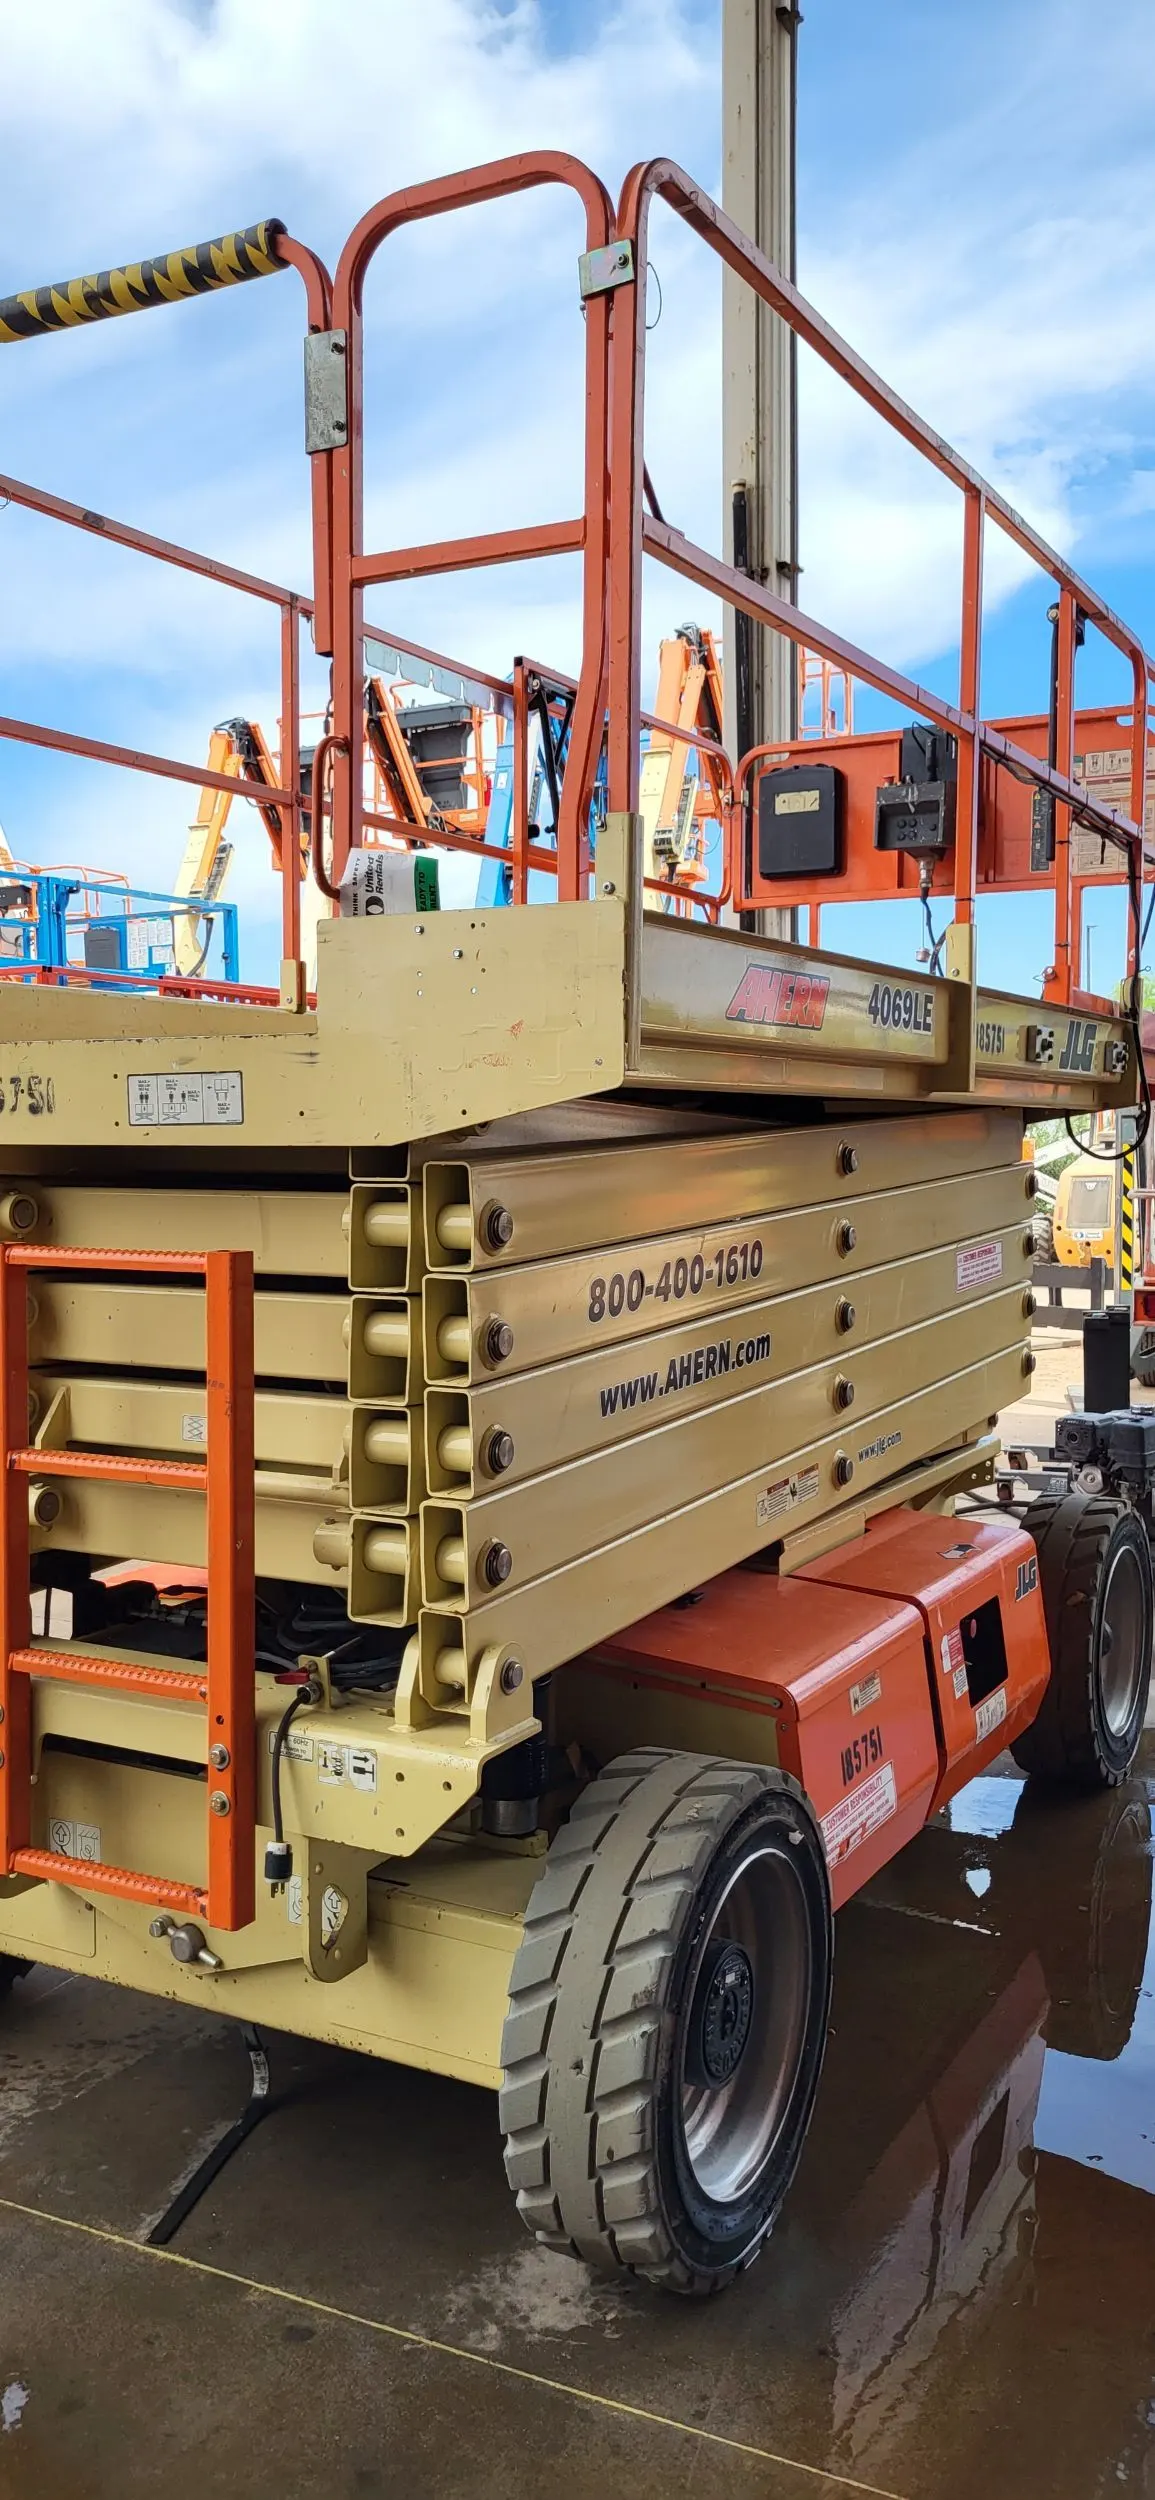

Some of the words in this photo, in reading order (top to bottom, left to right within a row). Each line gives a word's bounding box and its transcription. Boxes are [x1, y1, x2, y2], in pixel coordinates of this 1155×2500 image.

[352, 857, 361, 886] SAFETY
[364, 853, 375, 893] United
[375, 854, 384, 895] Rentals
[418, 871, 426, 885] TO
[419, 888, 427, 912] EADY
[727, 965, 829, 1030] AHERN
[867, 982, 935, 1034] 4069LE
[1059, 1019, 1097, 1073] JLG
[588, 1239, 763, 1323] 800-400-1610
[600, 1333, 771, 1417] www.AHERN.com
[858, 1431, 902, 1463] www.jlg.com
[1015, 1555, 1038, 1602] JLG
[840, 1725, 883, 1787] 185751
[825, 1803, 850, 1832] CUSTOMER
[849, 1775, 883, 1811] RESPONSIBILITY
